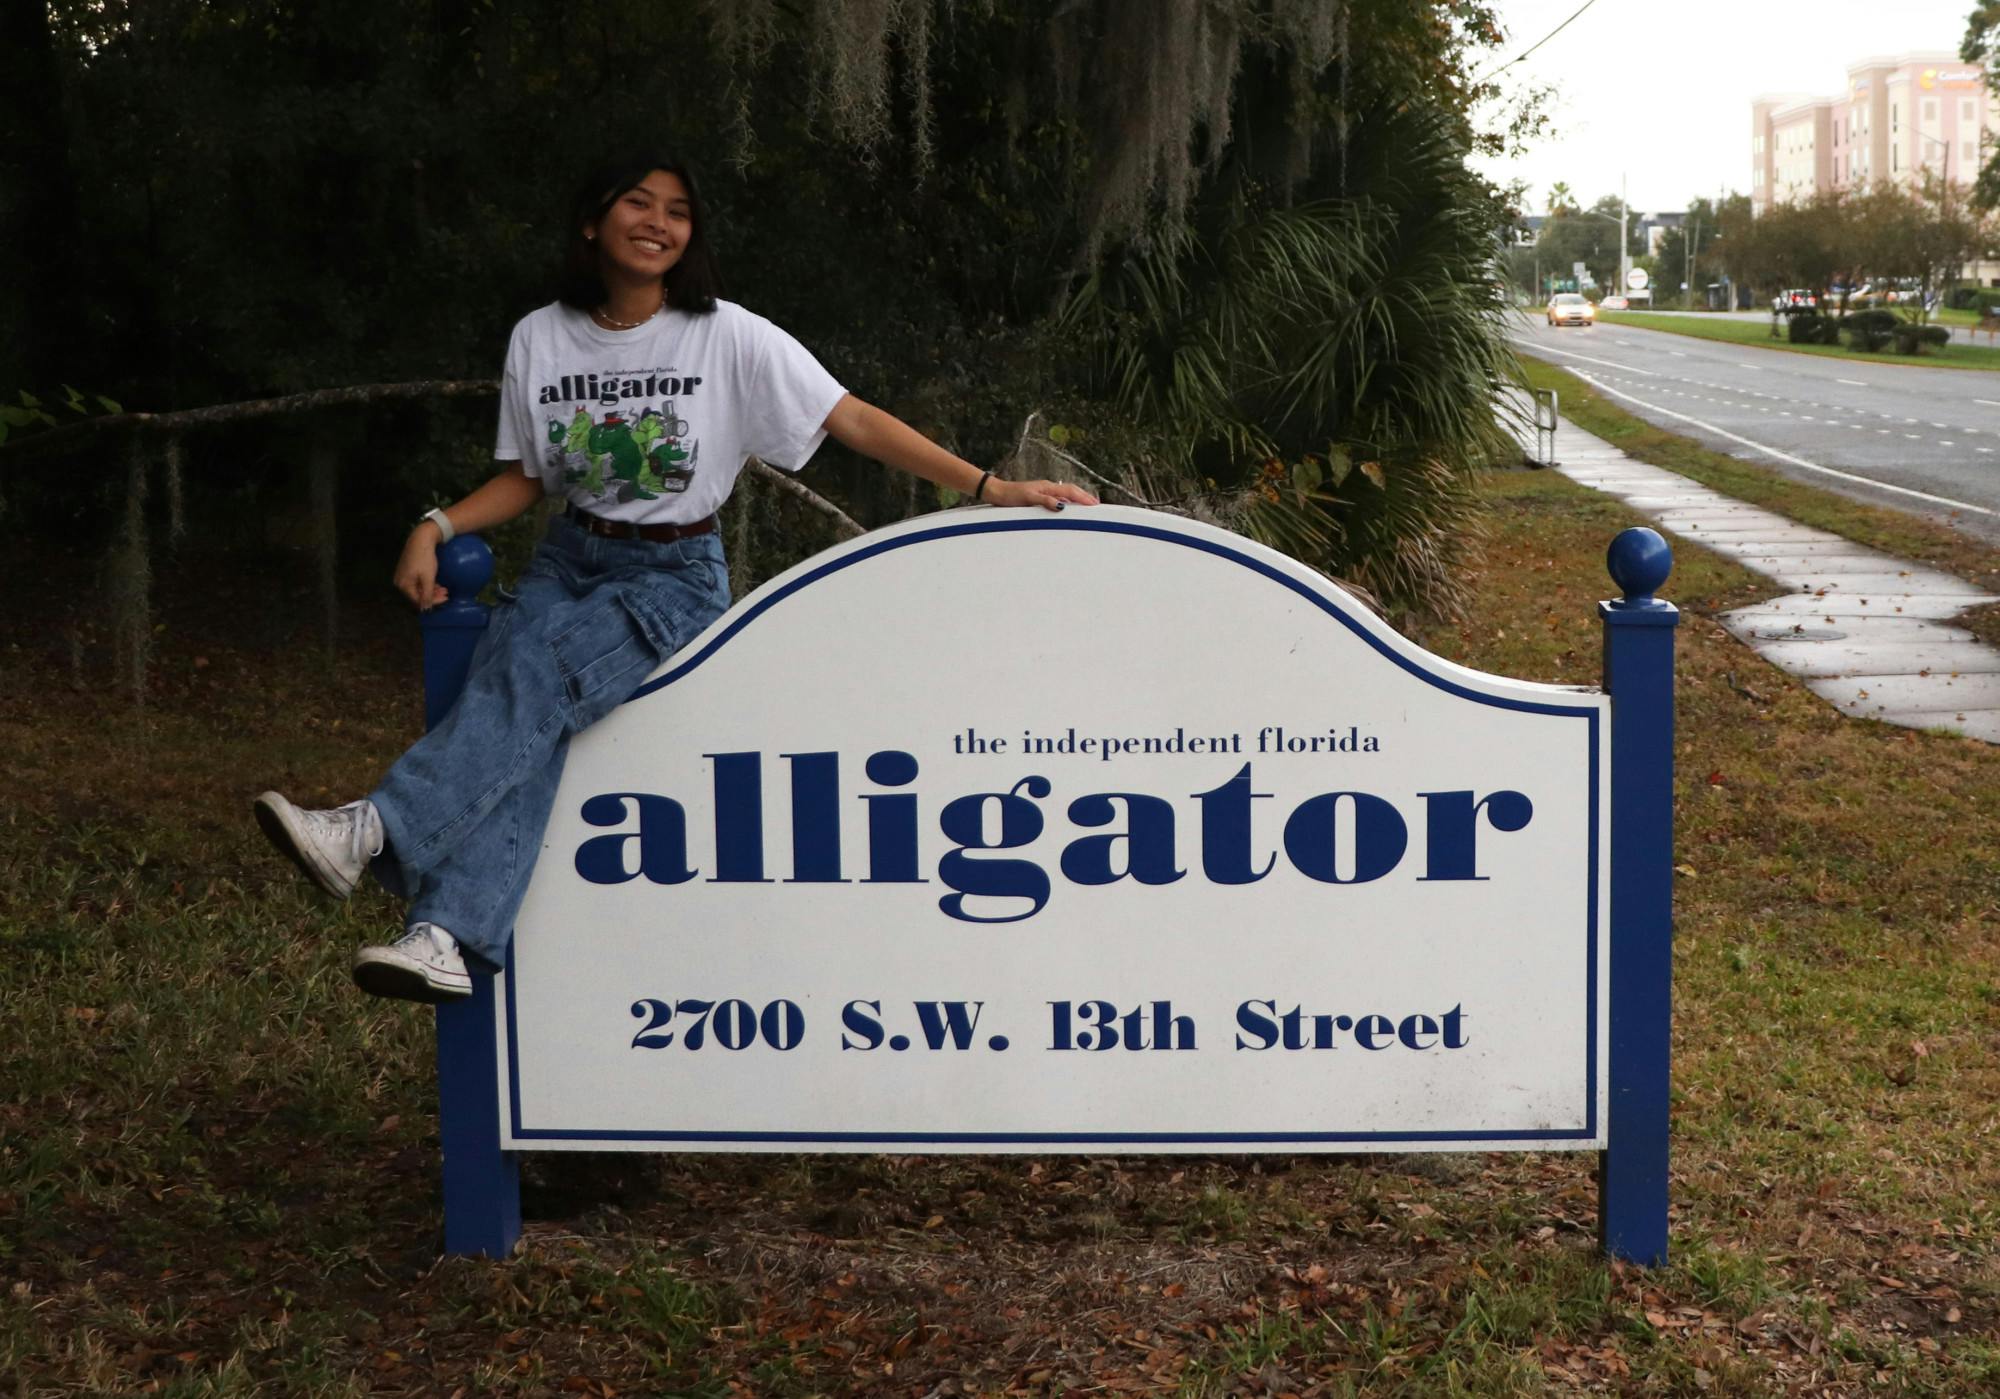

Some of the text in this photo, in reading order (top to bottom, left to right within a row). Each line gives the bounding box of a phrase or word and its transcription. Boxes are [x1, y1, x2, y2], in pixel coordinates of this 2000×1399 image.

[539, 374, 703, 407] alligator
[954, 726, 1381, 762] the independent florida
[574, 750, 1534, 924] alligator
[630, 998, 1470, 1052] 2700 S.W. 13th Street
